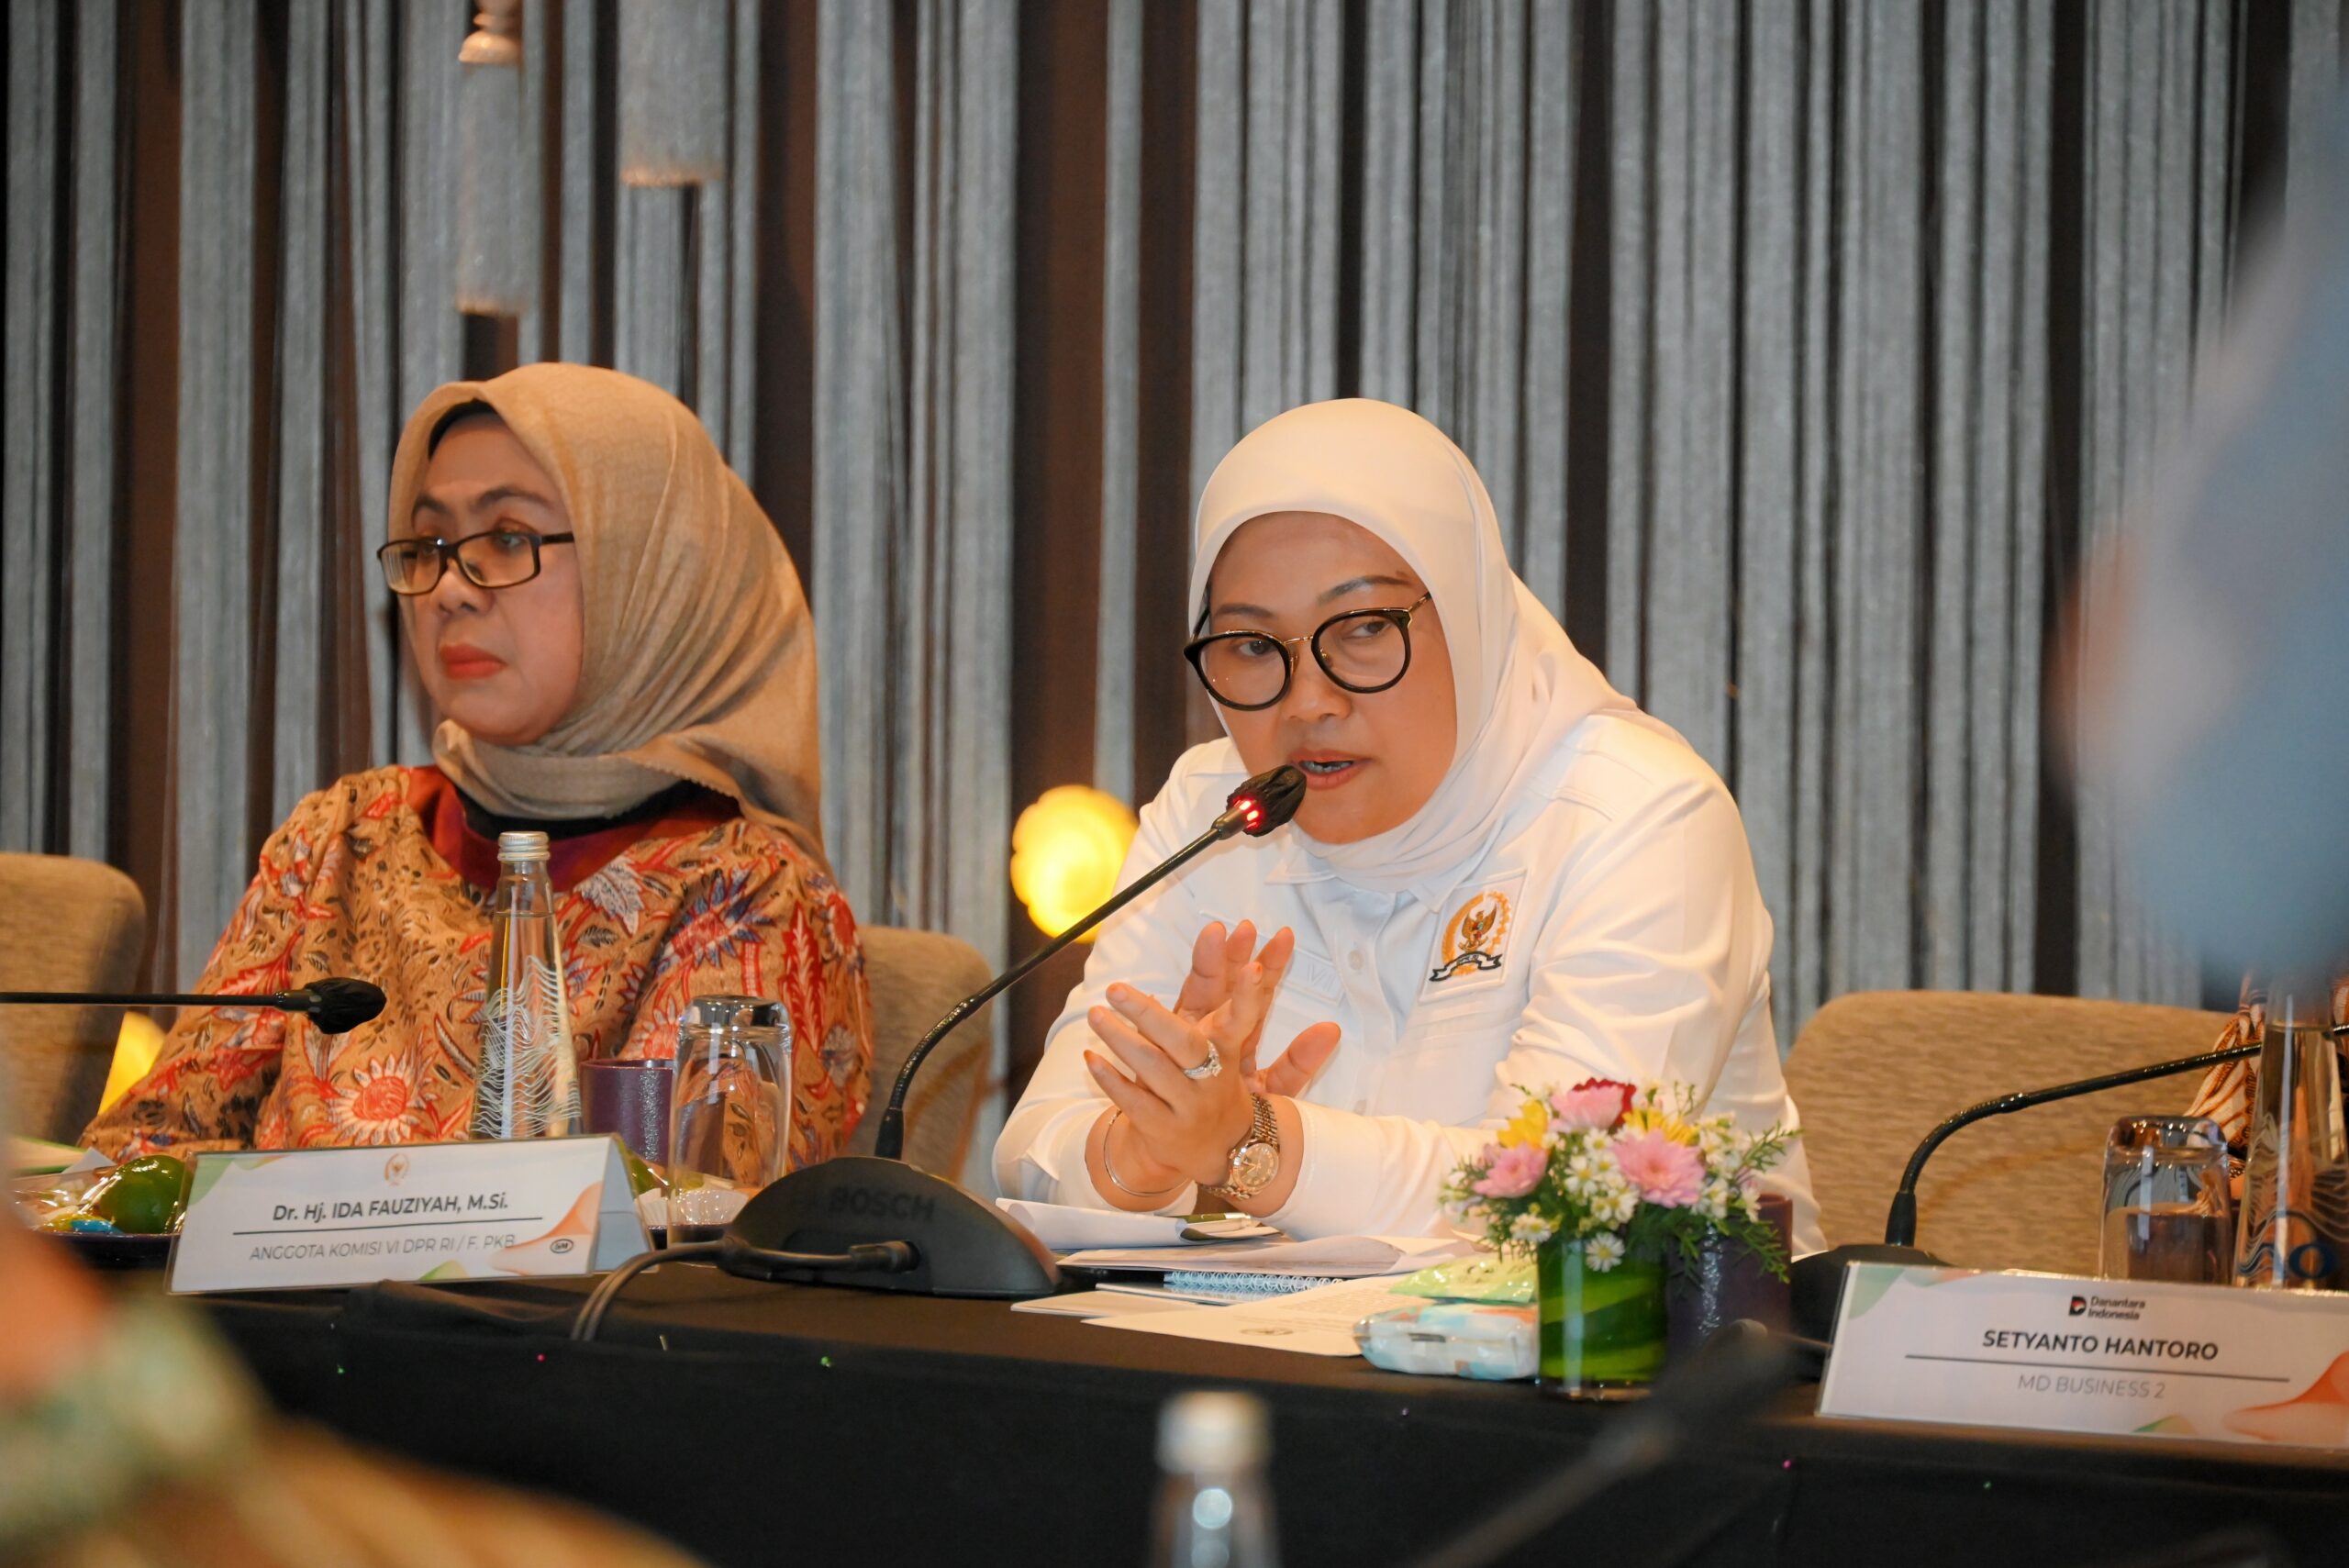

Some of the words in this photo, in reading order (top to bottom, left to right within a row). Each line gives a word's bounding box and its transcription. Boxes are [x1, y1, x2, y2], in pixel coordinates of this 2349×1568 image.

[273, 1205, 298, 1220] Dr.
[304, 1202, 327, 1223] Hj.
[332, 1202, 363, 1218] IDA
[368, 1196, 462, 1216] FAUZIYAH,
[467, 1192, 508, 1210] M.Si.
[829, 1185, 936, 1222] BOSCH
[249, 1244, 325, 1261] ANGGOTA
[328, 1240, 383, 1258] KOMISI
[385, 1240, 399, 1254] VI
[403, 1238, 437, 1254] DPR
[440, 1236, 455, 1251] RI
[466, 1235, 479, 1251] F.
[484, 1234, 516, 1249] PKB
[2087, 1308, 2141, 1321] Indonesia
[2089, 1296, 2146, 1309] Danantara
[1982, 1329, 2099, 1353] SETYANTO
[2105, 1337, 2219, 1361] HANTORO
[2018, 1374, 2051, 1392] MD
[2055, 1376, 2150, 1398] BUSINESS
[2153, 1382, 2166, 1399] 2
